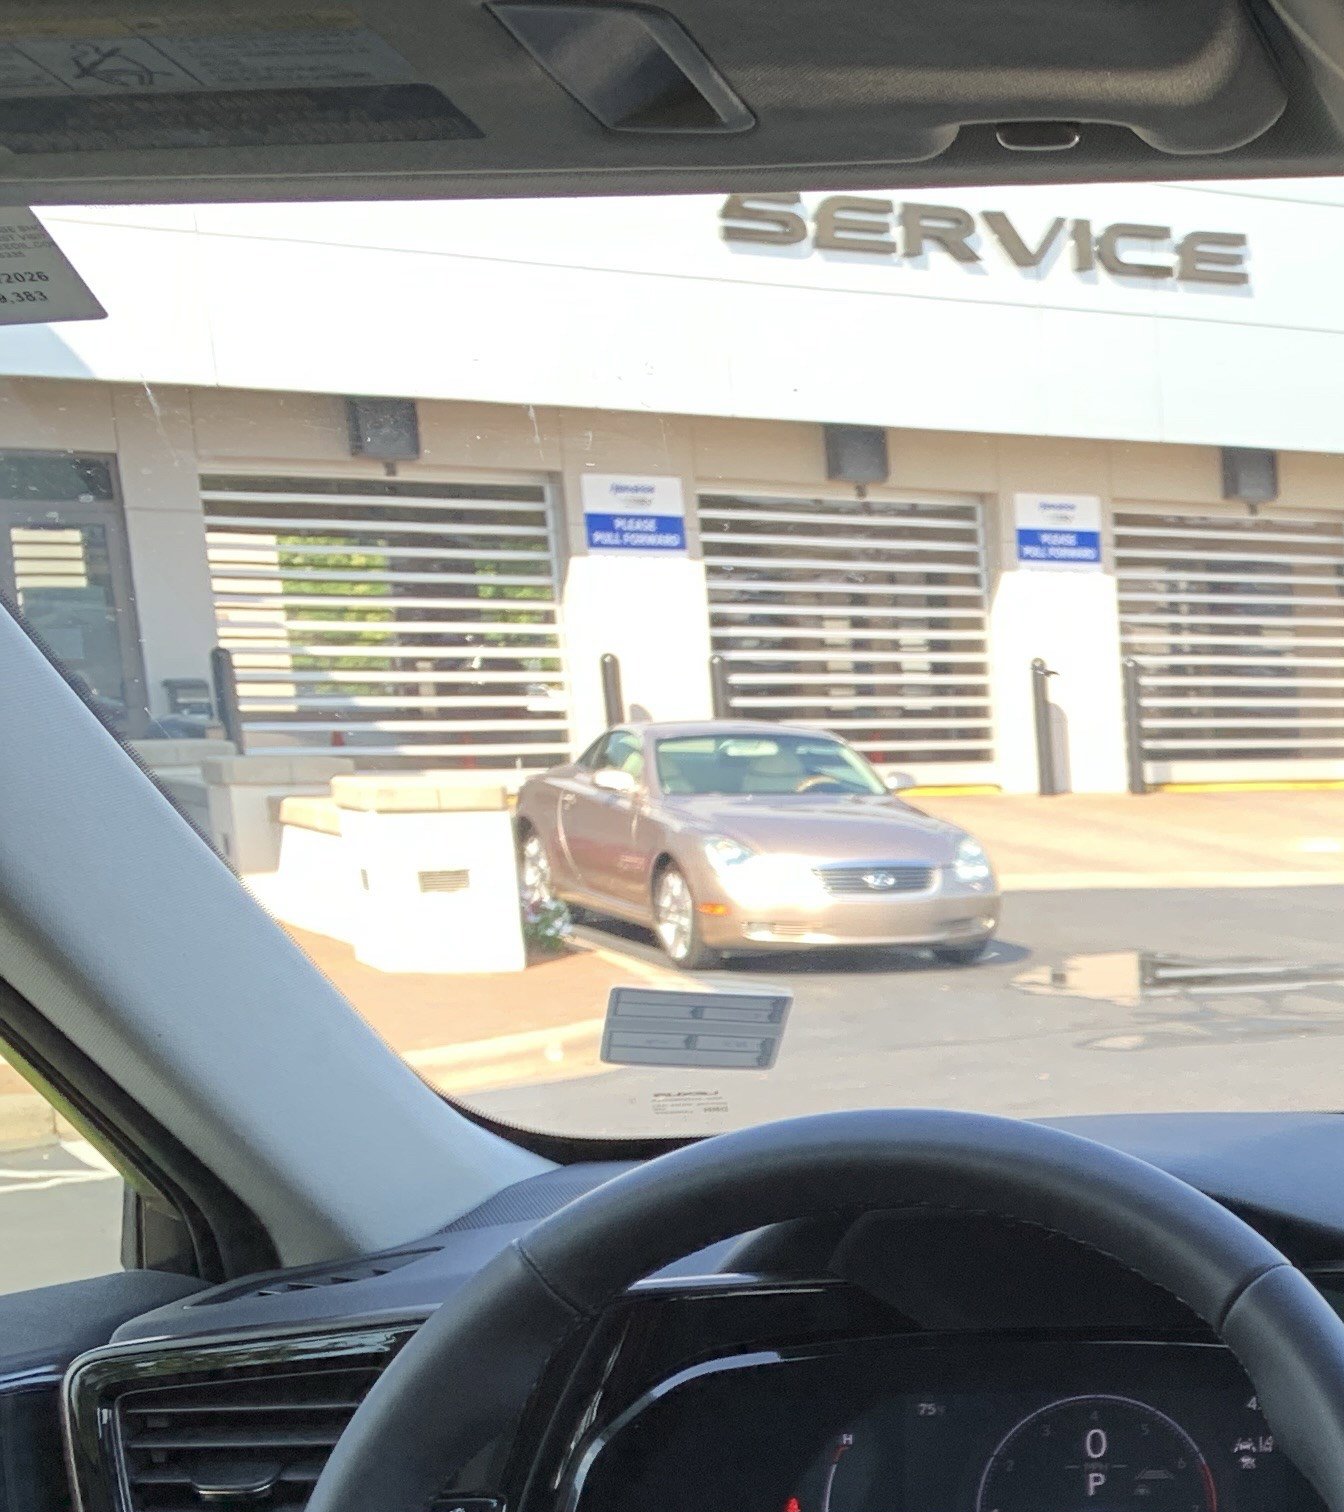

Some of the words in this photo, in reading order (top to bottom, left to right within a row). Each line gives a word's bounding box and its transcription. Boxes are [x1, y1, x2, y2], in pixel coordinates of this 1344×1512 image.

[718, 193, 1250, 286] SERVICE
[0, 271, 49, 284] 2026
[613, 518, 657, 531] PLEASE
[592, 531, 621, 545] PULL
[622, 532, 680, 547] FORWARD
[1040, 532, 1077, 546] PLEASE
[842, 1433, 853, 1444] H
[1086, 1428, 1107, 1459] 0
[1088, 1473, 1106, 1496] P
